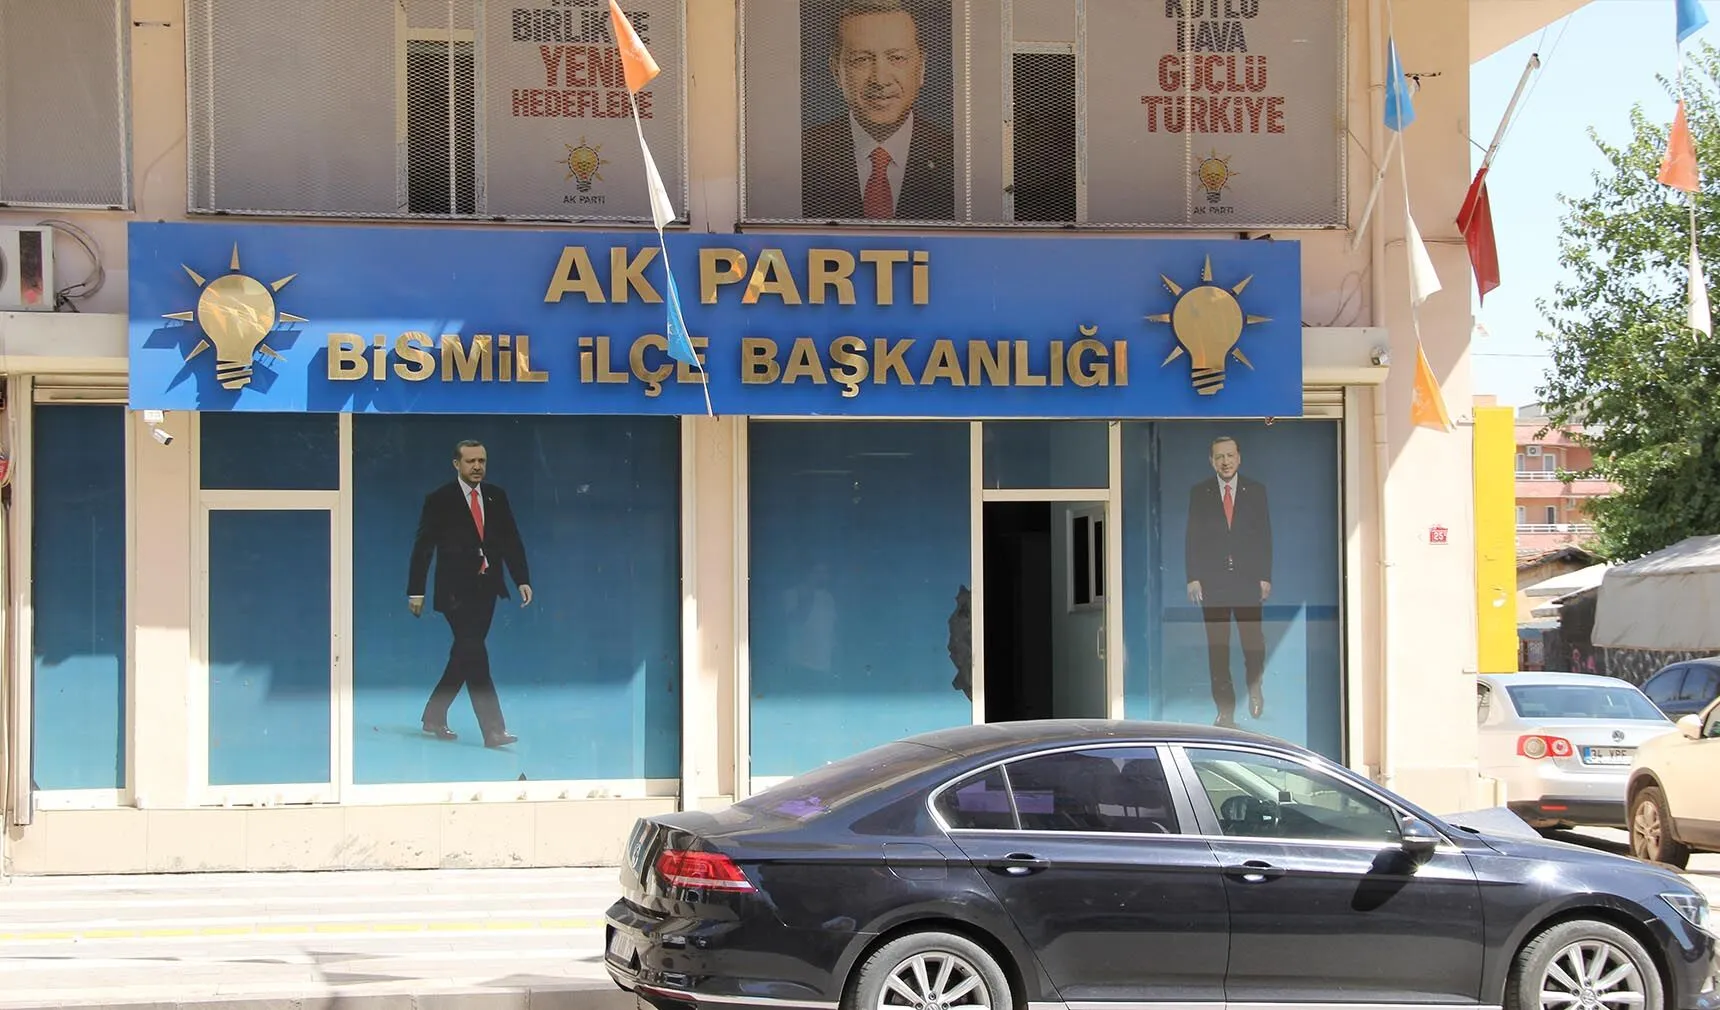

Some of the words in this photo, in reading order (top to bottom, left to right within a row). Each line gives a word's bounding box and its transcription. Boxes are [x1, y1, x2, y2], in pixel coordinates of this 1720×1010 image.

[1177, 20, 1248, 53] HAVA
[512, 89, 653, 119] HEDEFLERE
[1141, 96, 1285, 133] TÜRKİYE
[563, 195, 577, 204] AK
[544, 246, 664, 304] AK
[742, 325, 1130, 397] BAŞKANLIĞI
